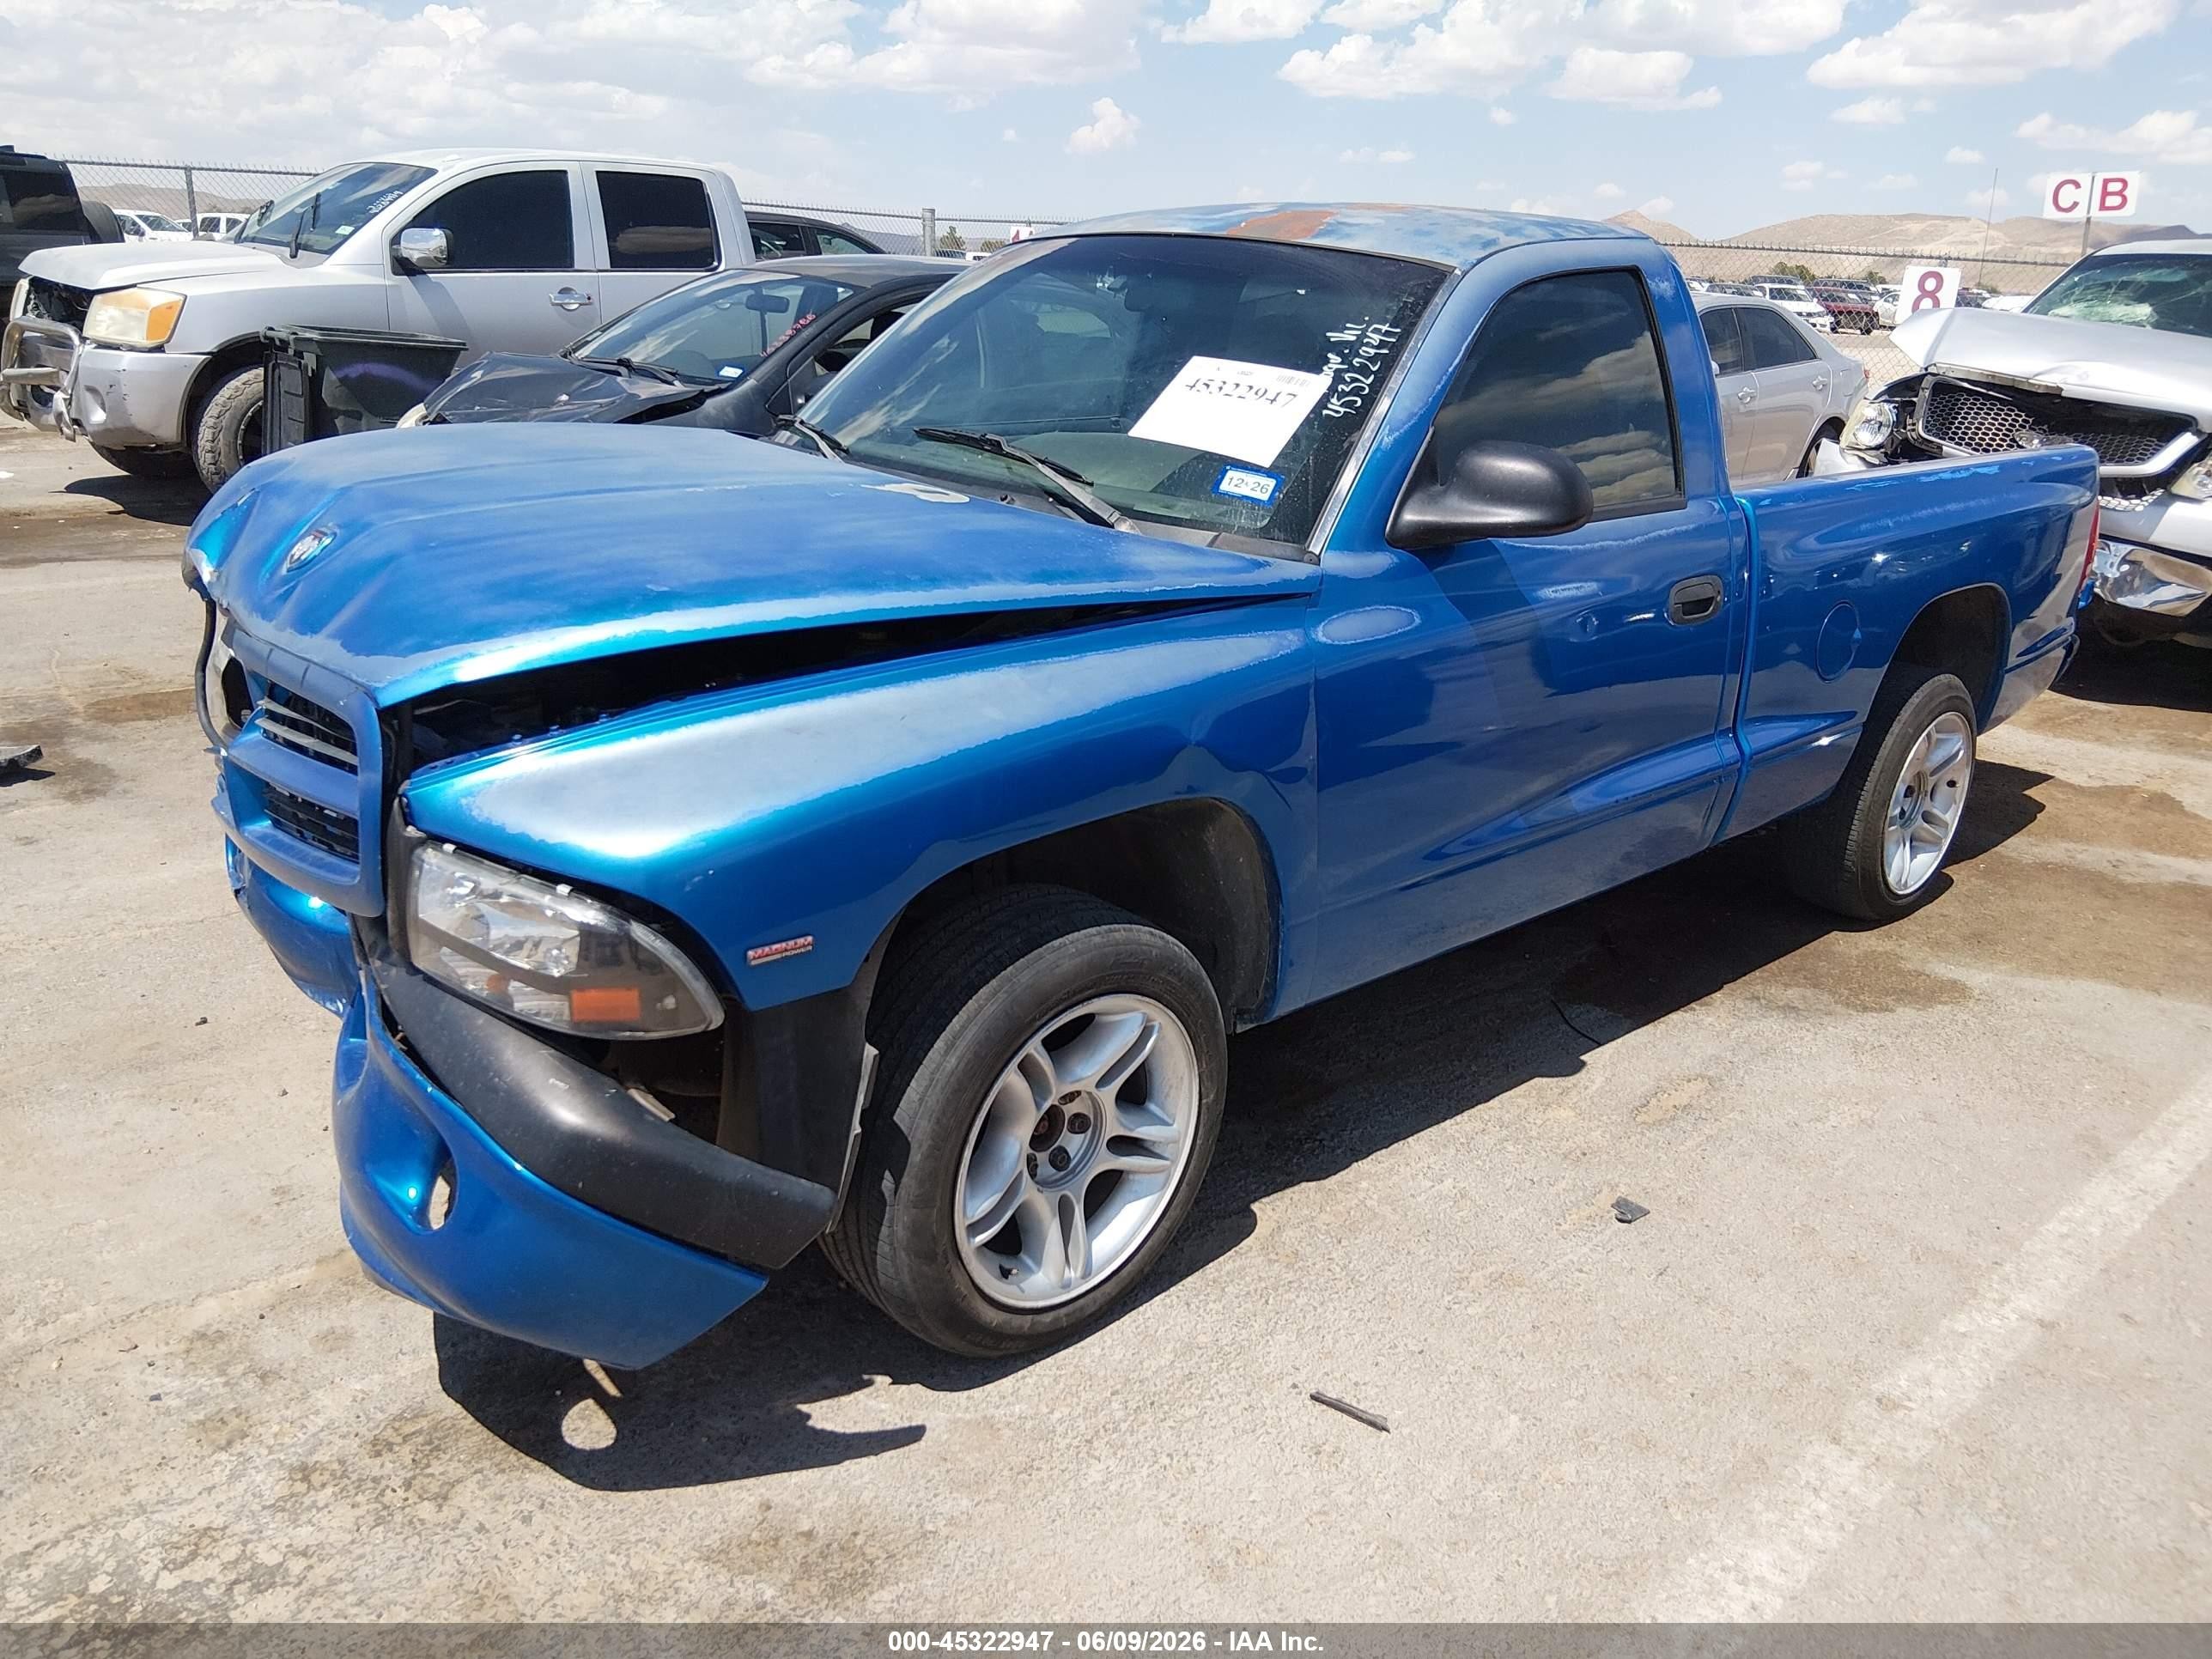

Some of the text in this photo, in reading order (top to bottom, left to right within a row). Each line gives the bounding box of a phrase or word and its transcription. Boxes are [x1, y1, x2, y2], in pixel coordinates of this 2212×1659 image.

[2052, 179, 2081, 213] C
[2098, 177, 2129, 211] B
[1911, 270, 1944, 315] 8
[1322, 323, 1401, 417] 45322947
[1185, 378, 1297, 408] 45322947
[750, 937, 812, 959] MAGNUM
